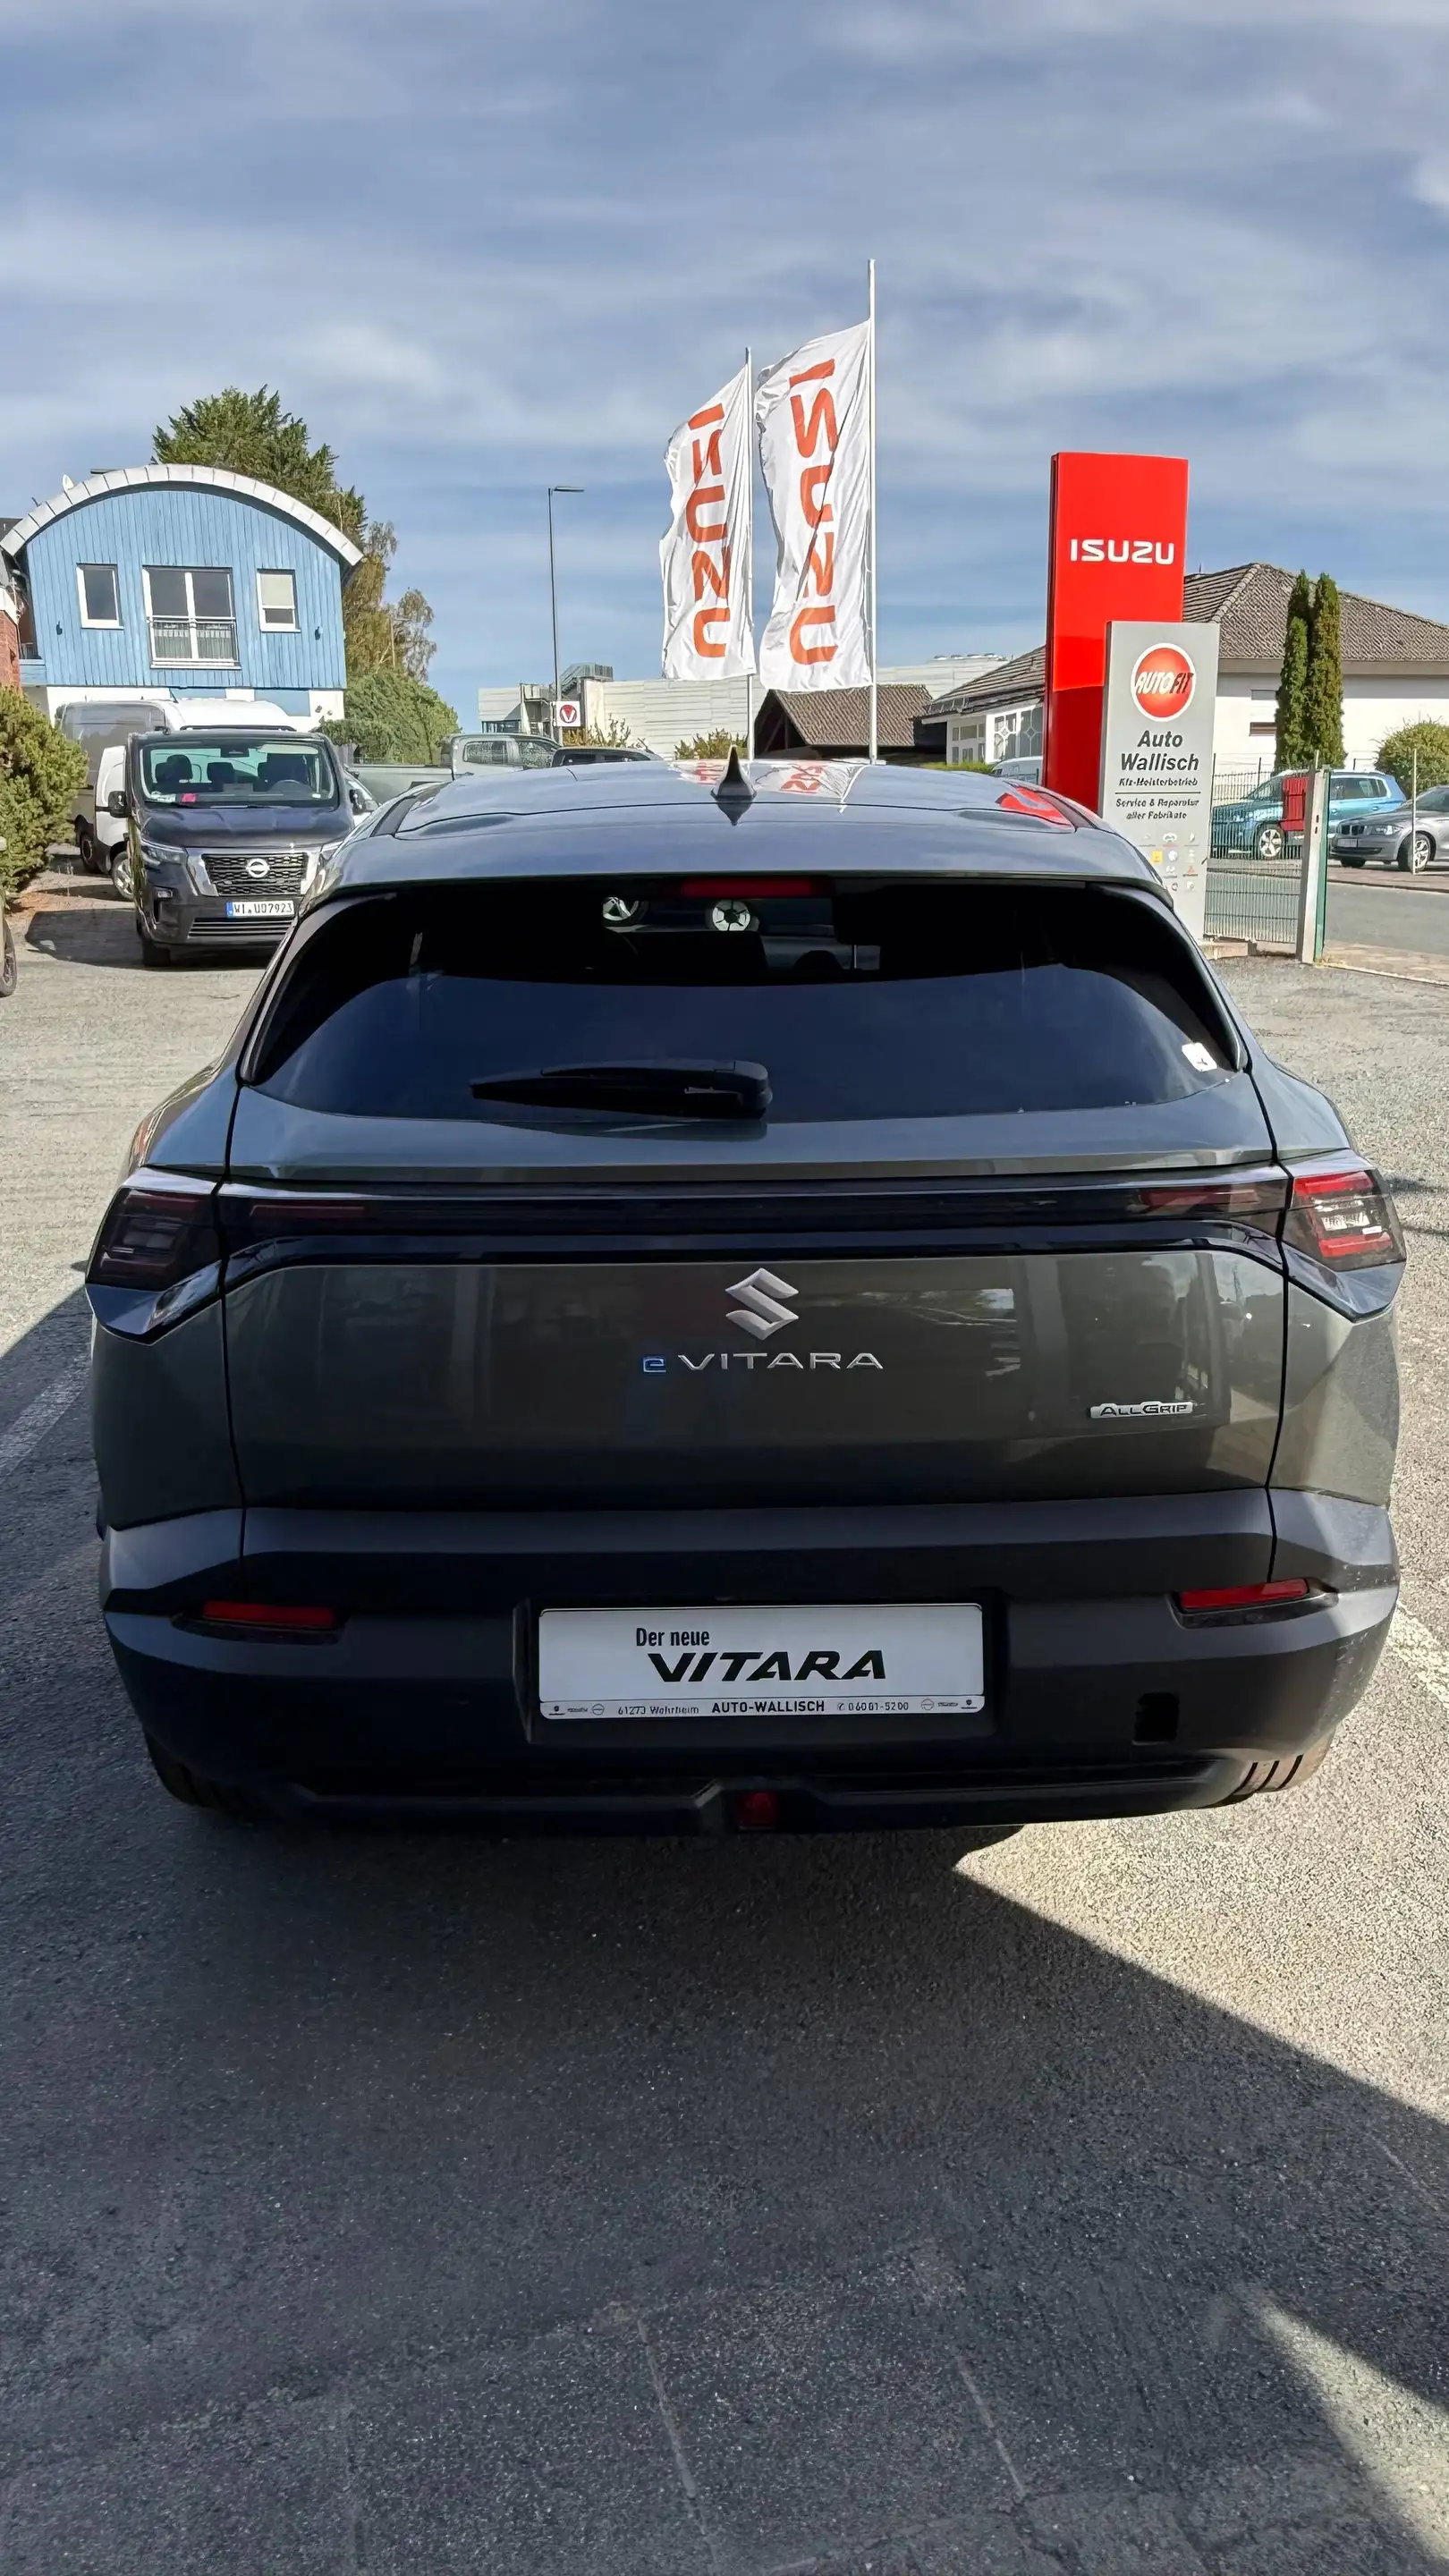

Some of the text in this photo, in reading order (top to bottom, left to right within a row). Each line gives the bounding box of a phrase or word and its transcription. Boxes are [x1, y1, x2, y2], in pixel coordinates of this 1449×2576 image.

[790, 358, 839, 665] ISUZU
[687, 402, 731, 657] ISUZU
[1070, 538, 1174, 565] ISUZU
[1137, 730, 1183, 748] Auto
[1121, 753, 1199, 771] Wallisch
[1115, 798, 1147, 808] Service
[677, 1352, 884, 1370] VITARA
[636, 1628, 710, 1647] Der neue
[648, 1649, 886, 1682] VITARA
[618, 1706, 646, 1716] 61273
[711, 1700, 825, 1714] AUTO-WALLISCH
